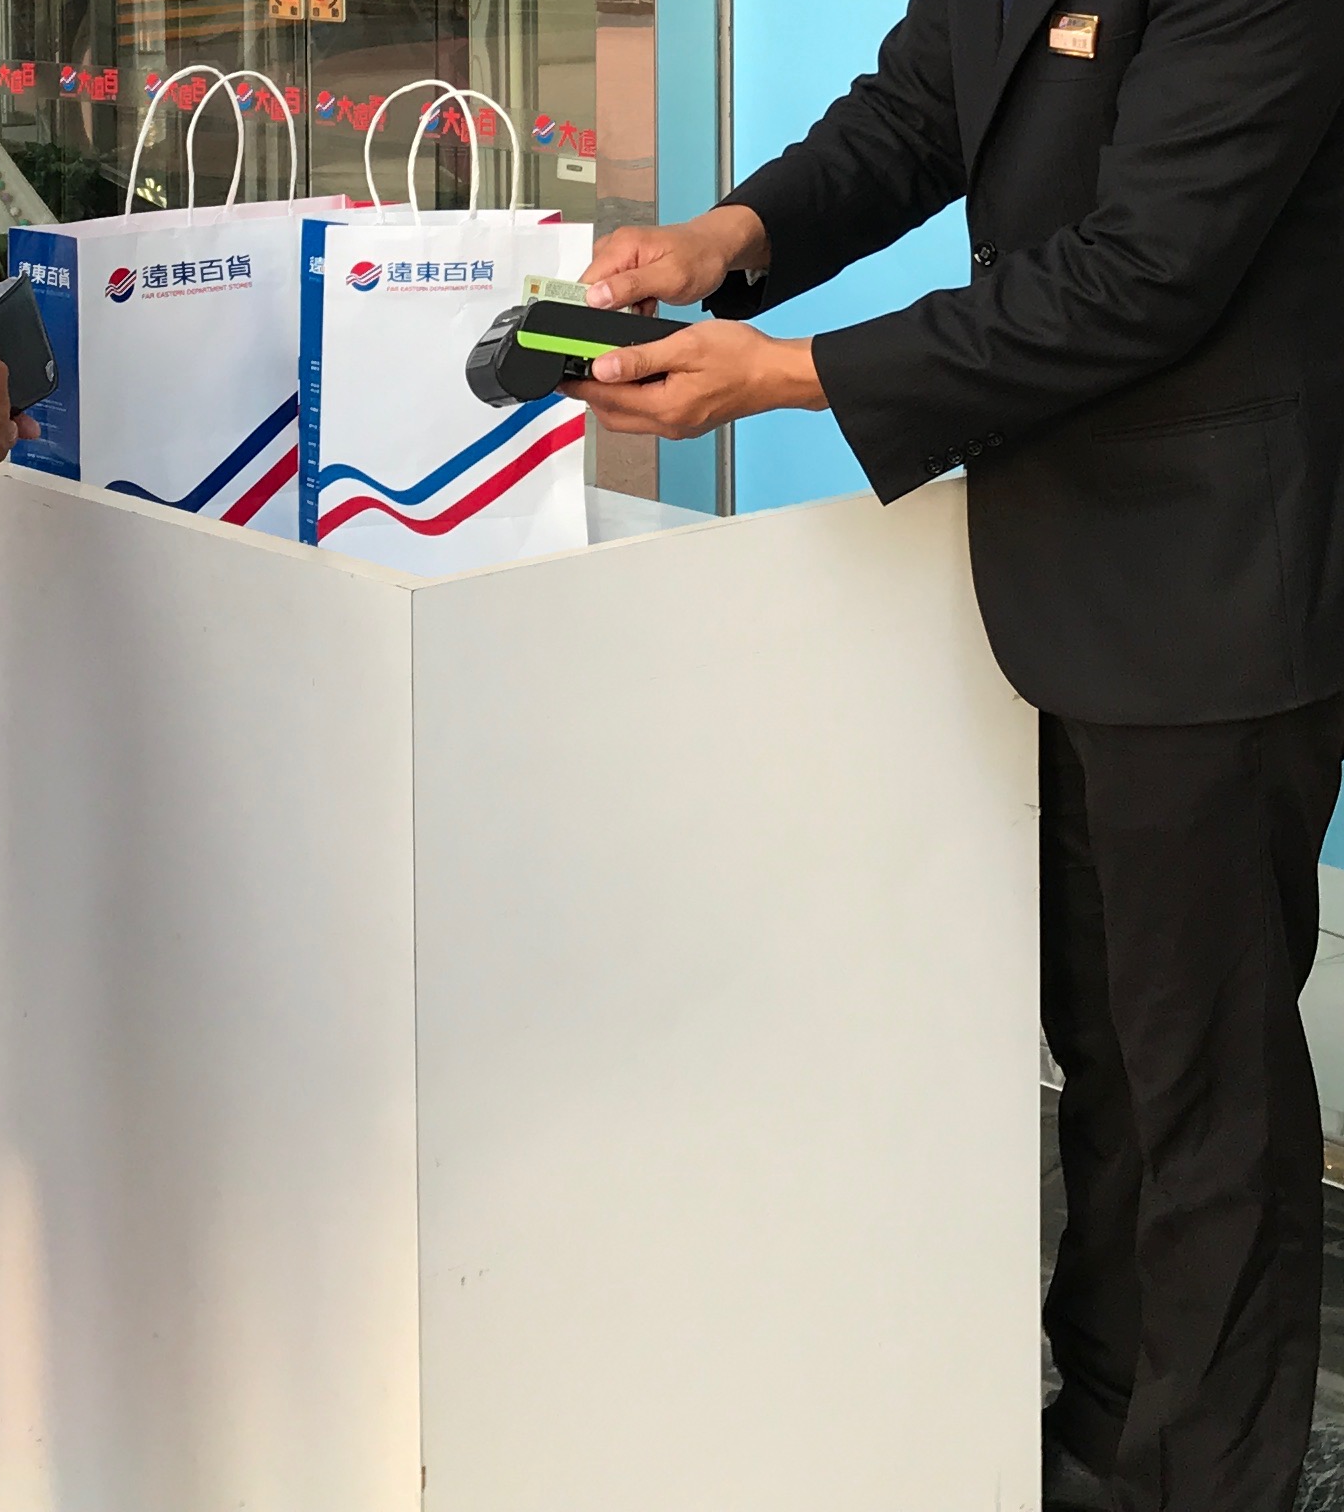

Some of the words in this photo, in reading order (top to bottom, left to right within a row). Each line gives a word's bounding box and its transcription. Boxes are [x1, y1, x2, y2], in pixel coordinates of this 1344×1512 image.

[77, 68, 119, 101] 大遠百
[142, 254, 252, 289] 遠東百貨
[387, 260, 495, 283] 遠東百貨
[141, 292, 155, 300] FAR
[228, 281, 253, 292] STORES
